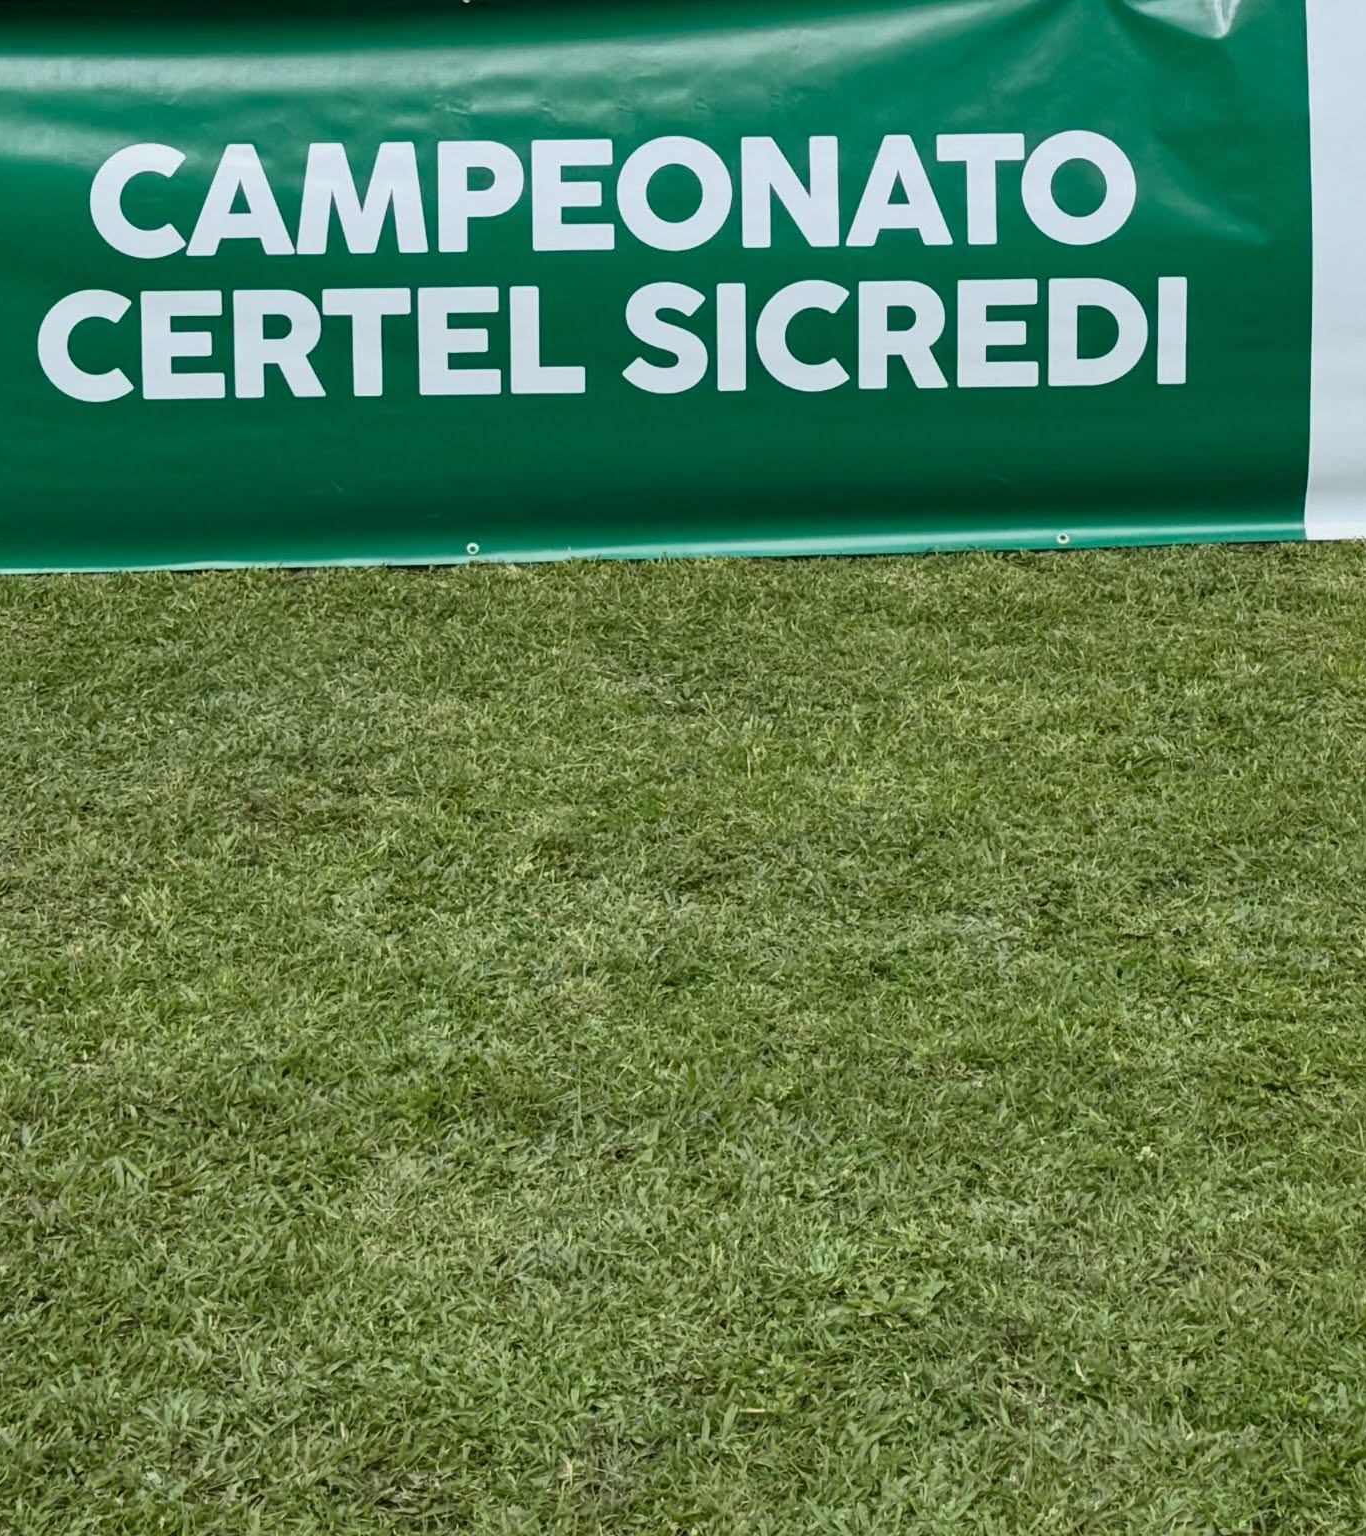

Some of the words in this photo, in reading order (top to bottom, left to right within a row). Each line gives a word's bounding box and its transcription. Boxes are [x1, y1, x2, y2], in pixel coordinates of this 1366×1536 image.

[89, 130, 1136, 259] CAMPEONATO
[37, 286, 586, 402] CERTEL
[622, 276, 1187, 394] SICREDI
